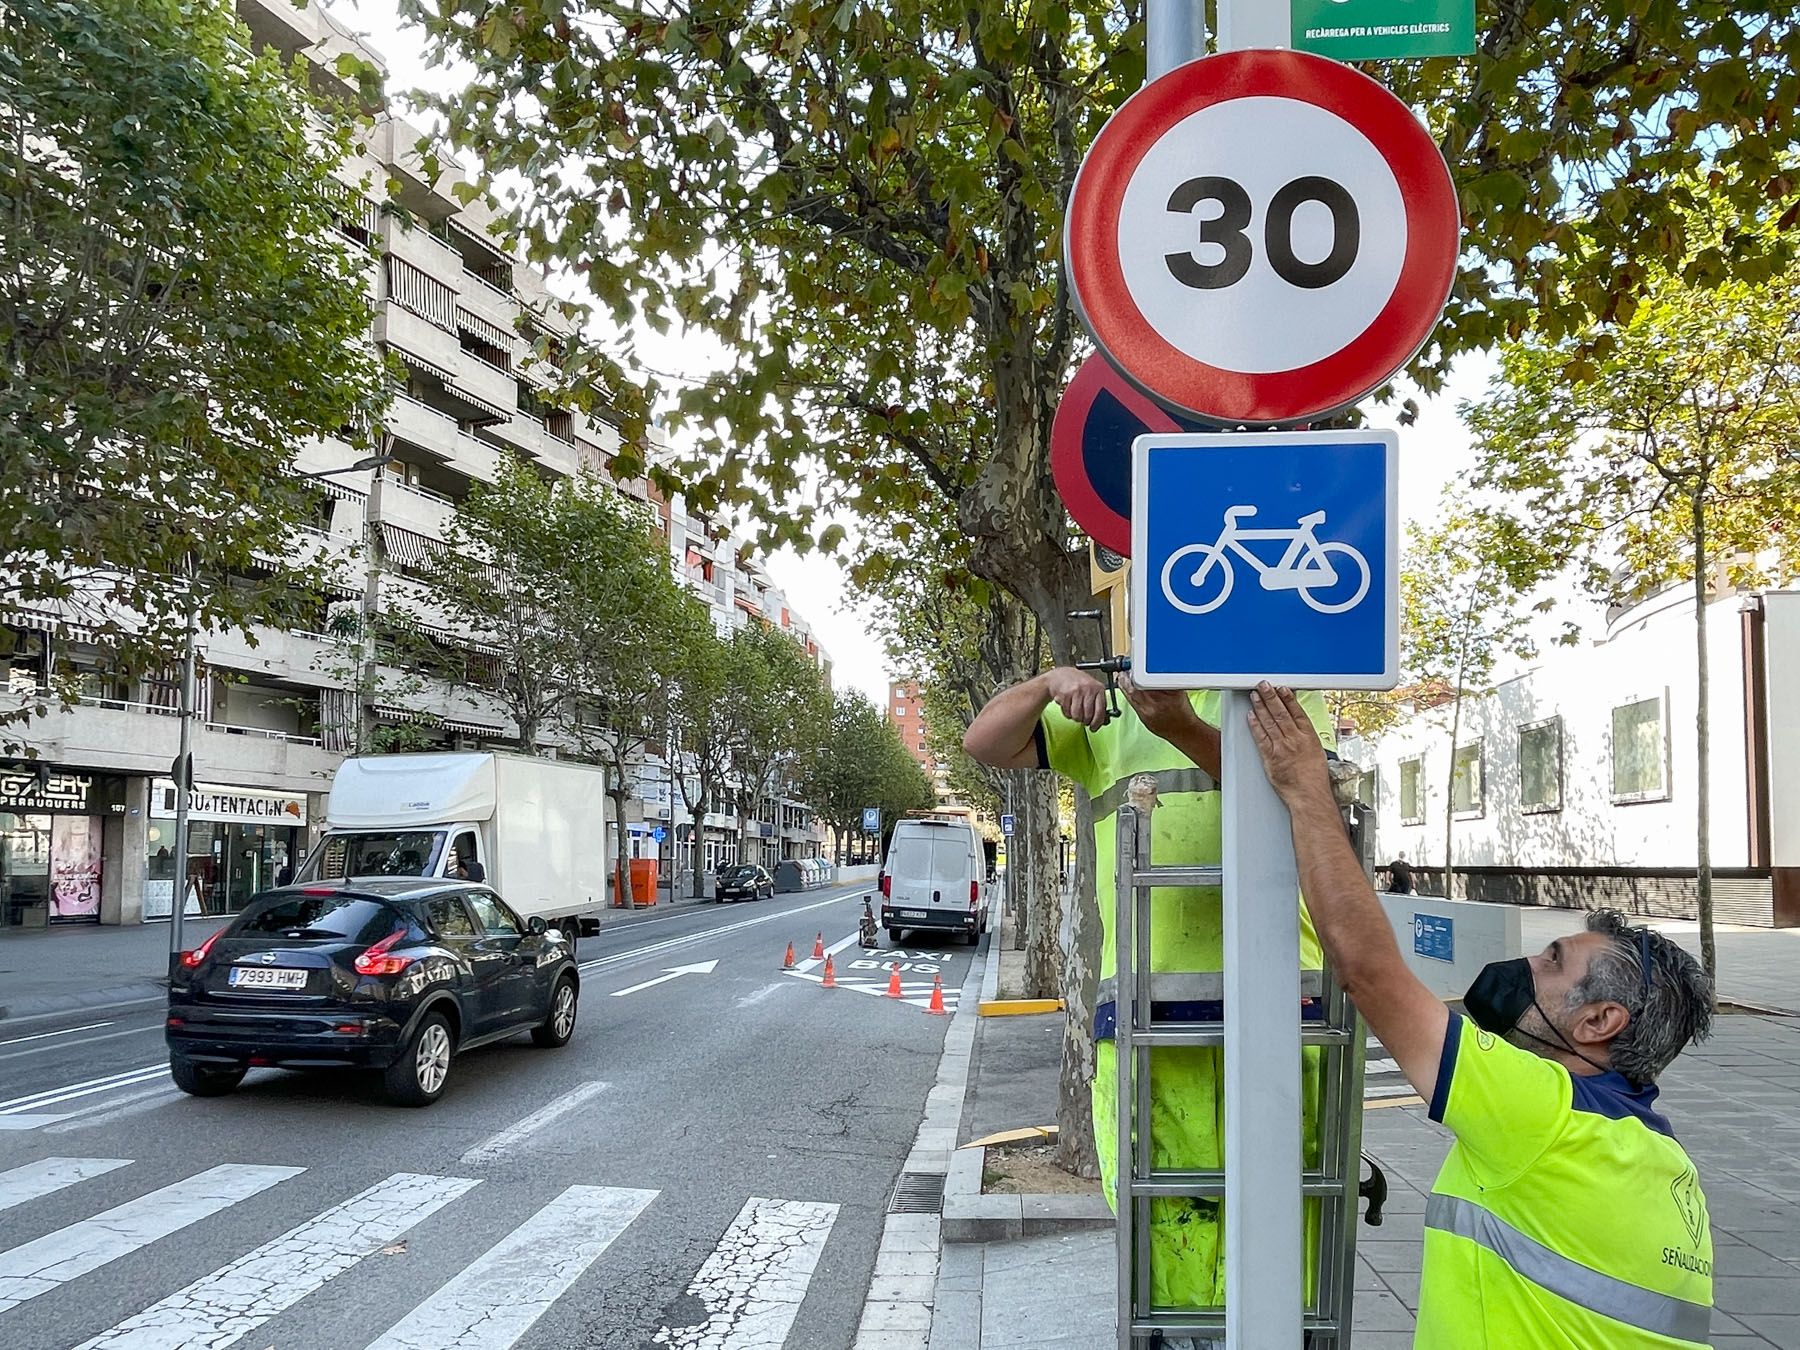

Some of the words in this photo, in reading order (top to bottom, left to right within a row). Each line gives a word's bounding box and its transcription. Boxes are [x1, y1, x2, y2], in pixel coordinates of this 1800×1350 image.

[1305, 27, 1350, 39] RECÀRREGA
[1350, 27, 1365, 37] PER
[1366, 26, 1373, 36] A
[1373, 25, 1409, 36] VEHICLES
[1164, 175, 1361, 290] 30
[863, 948, 953, 962] TAXI
[848, 960, 941, 974] BUS
[239, 970, 273, 983] 7993
[1662, 1246, 1713, 1276] SEÑALIZACIO
